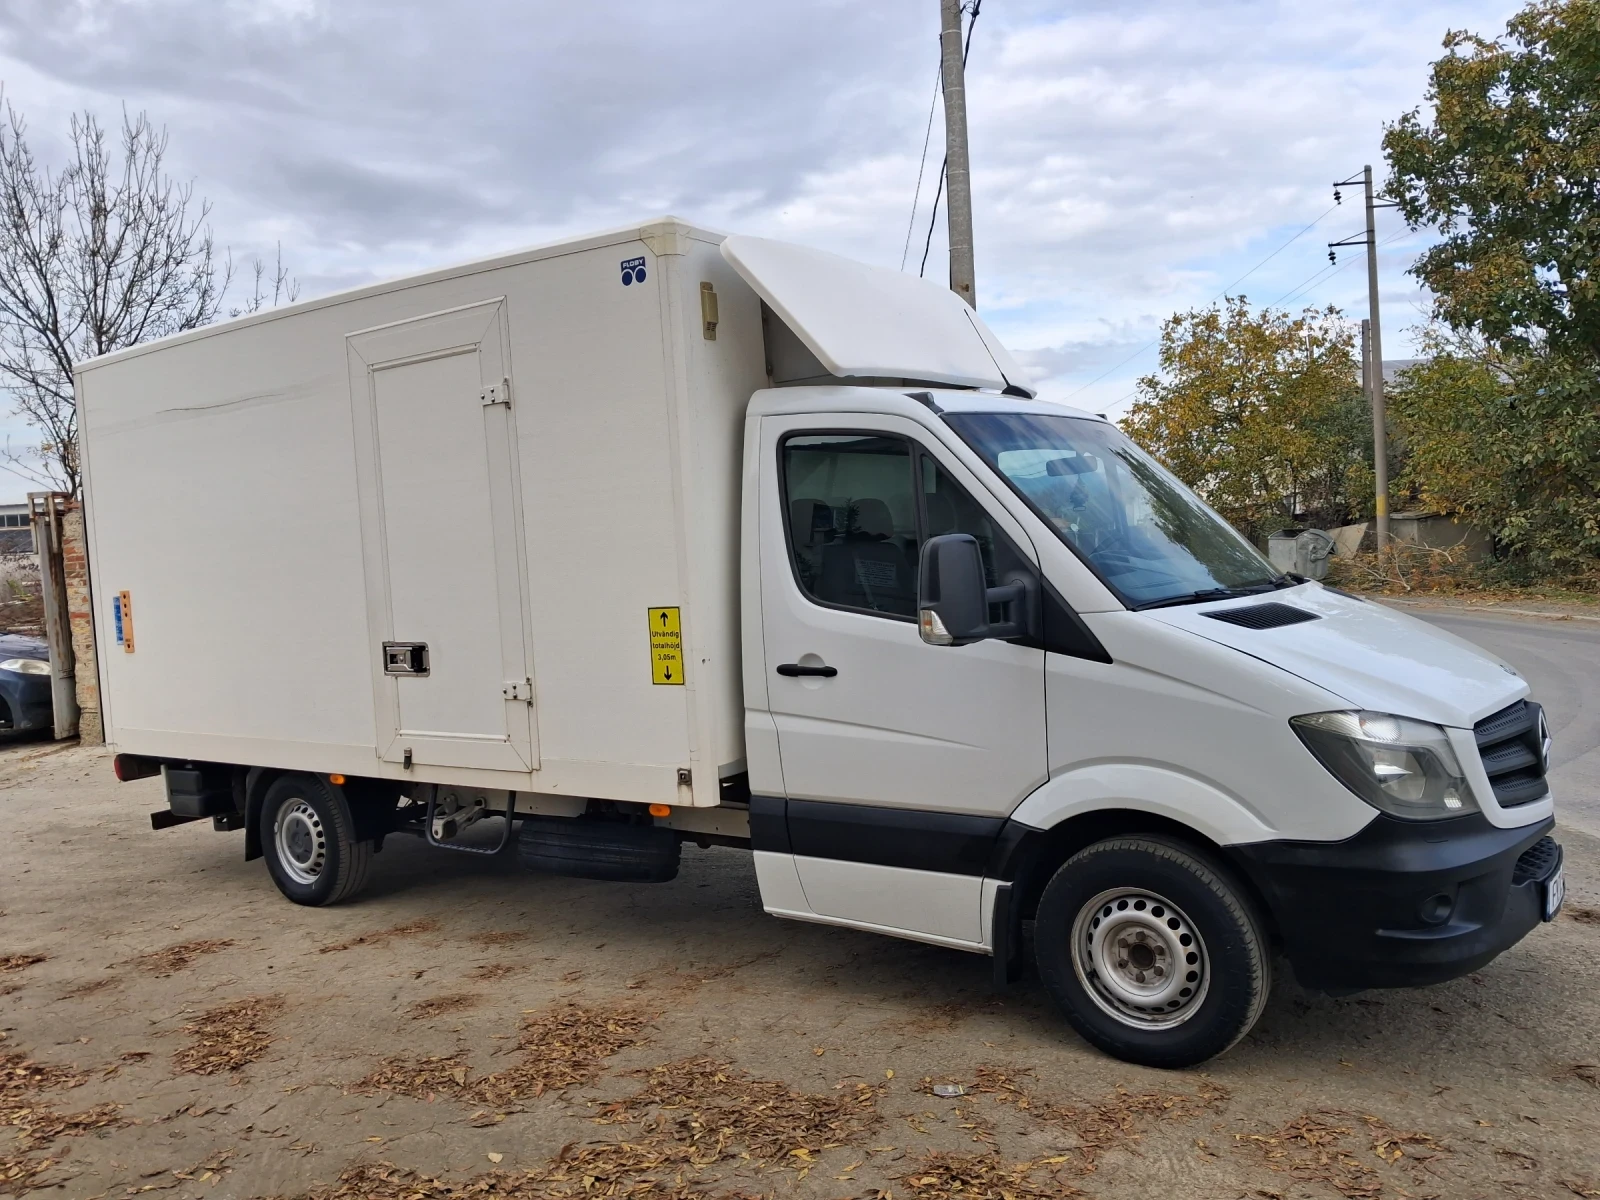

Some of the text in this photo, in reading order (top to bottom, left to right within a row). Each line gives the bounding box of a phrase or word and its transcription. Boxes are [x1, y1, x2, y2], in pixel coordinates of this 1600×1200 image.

[622, 258, 644, 268] FLOBY
[652, 630, 680, 638] Utvändig
[652, 642, 680, 650] totalhöjd
